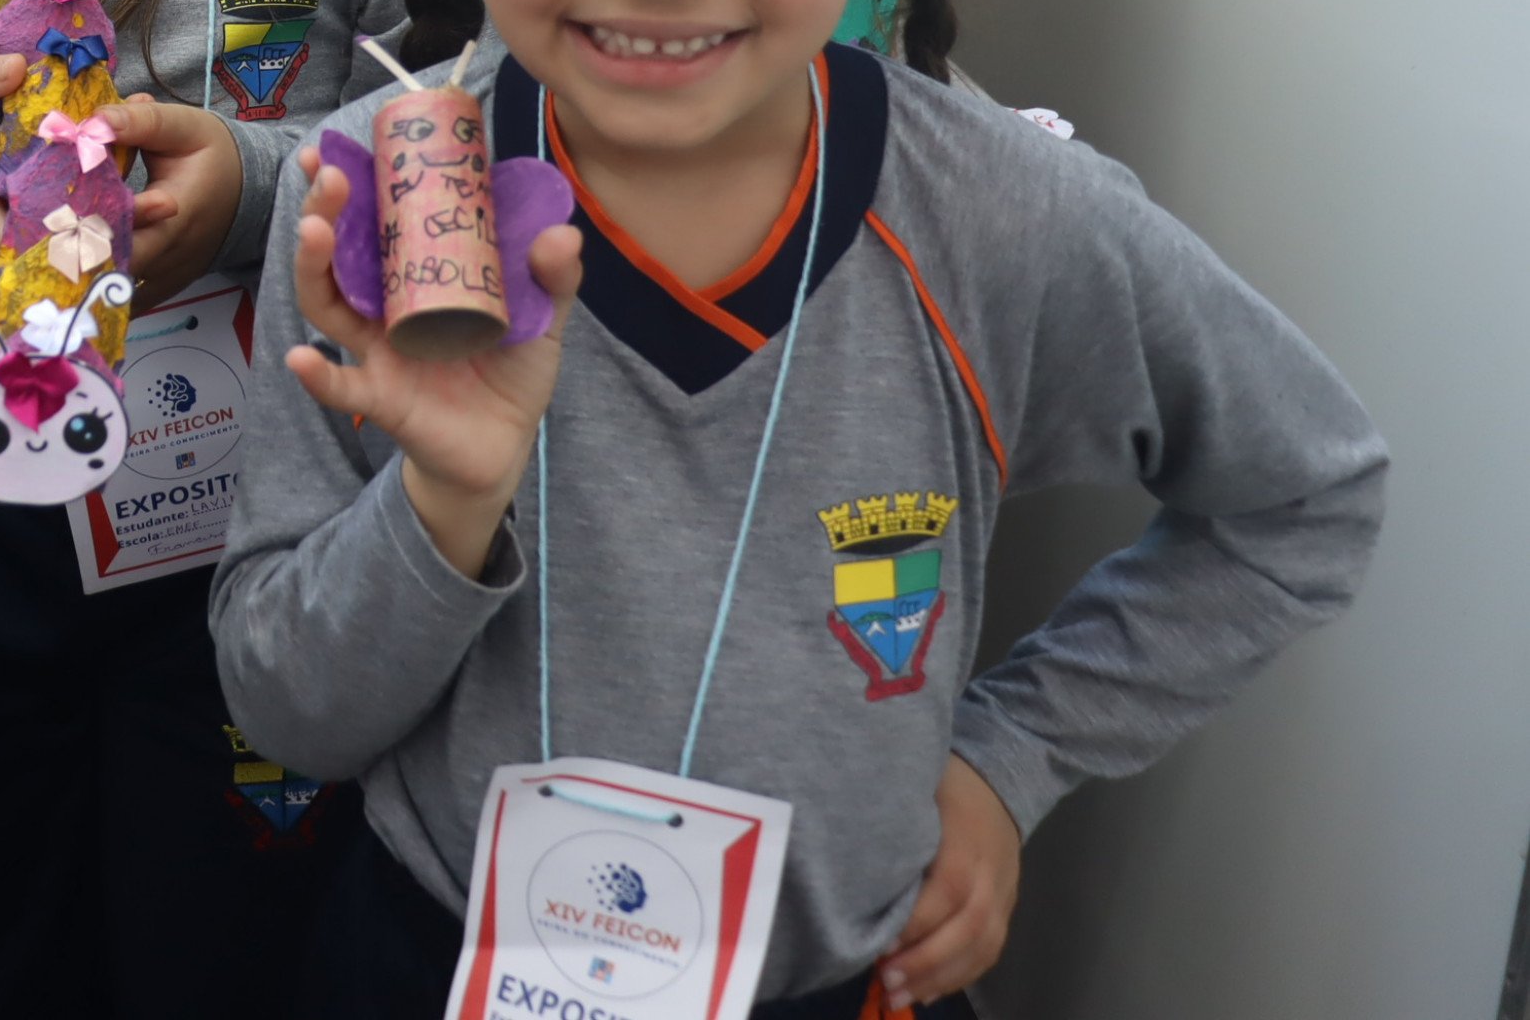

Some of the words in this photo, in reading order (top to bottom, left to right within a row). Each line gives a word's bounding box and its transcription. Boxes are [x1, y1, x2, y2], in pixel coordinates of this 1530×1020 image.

[127, 427, 158, 447] XIV
[165, 407, 233, 437] FEICON
[170, 424, 240, 446] CONHECIMENTO
[116, 511, 189, 535] Estudante:
[118, 533, 164, 548] Escola:
[544, 899, 586, 924] XIV
[593, 913, 681, 952] FEICON
[497, 974, 635, 1020] EXPOS
